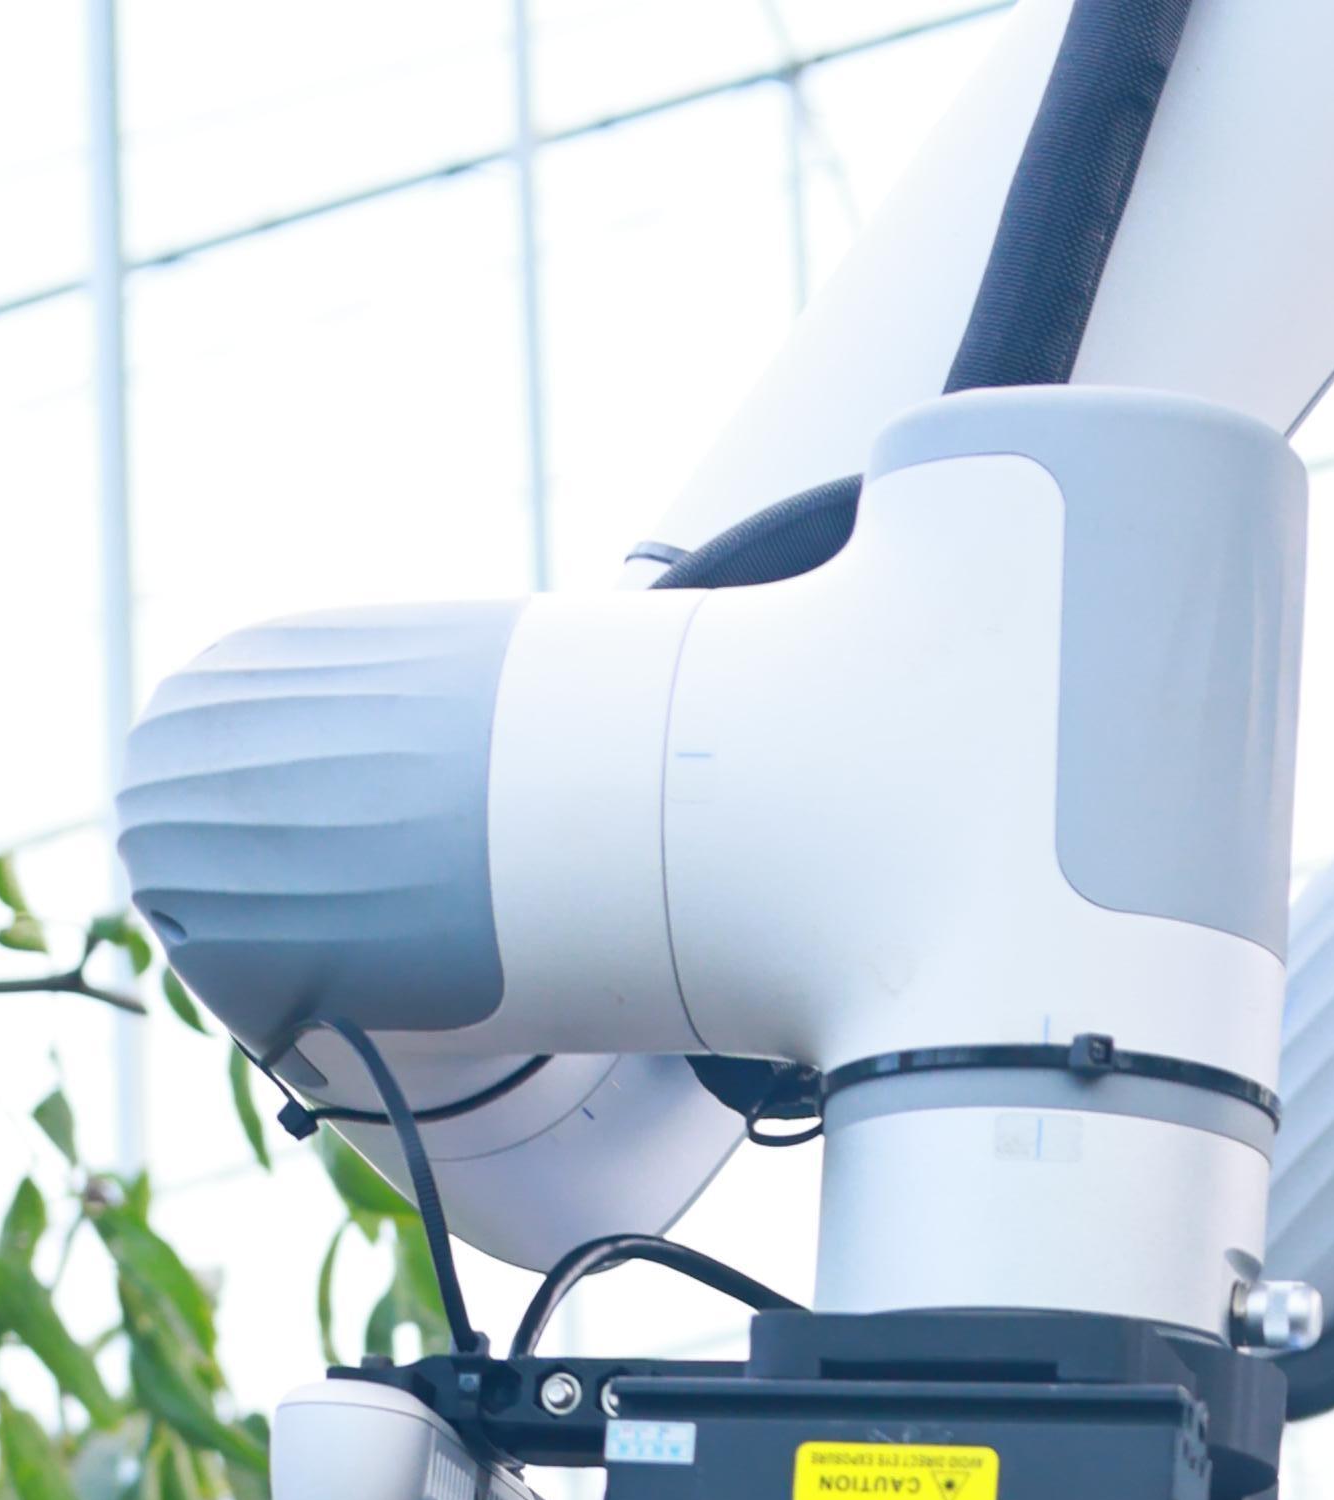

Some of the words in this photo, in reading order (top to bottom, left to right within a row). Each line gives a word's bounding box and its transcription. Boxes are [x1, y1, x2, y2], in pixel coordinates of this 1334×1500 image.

[810, 1452, 874, 1466] EXPOSURE
[878, 1454, 900, 1466] EYE
[902, 1455, 946, 1468] DIRECT
[949, 1456, 982, 1468] AVOID
[819, 1475, 921, 1494] CAUTION
